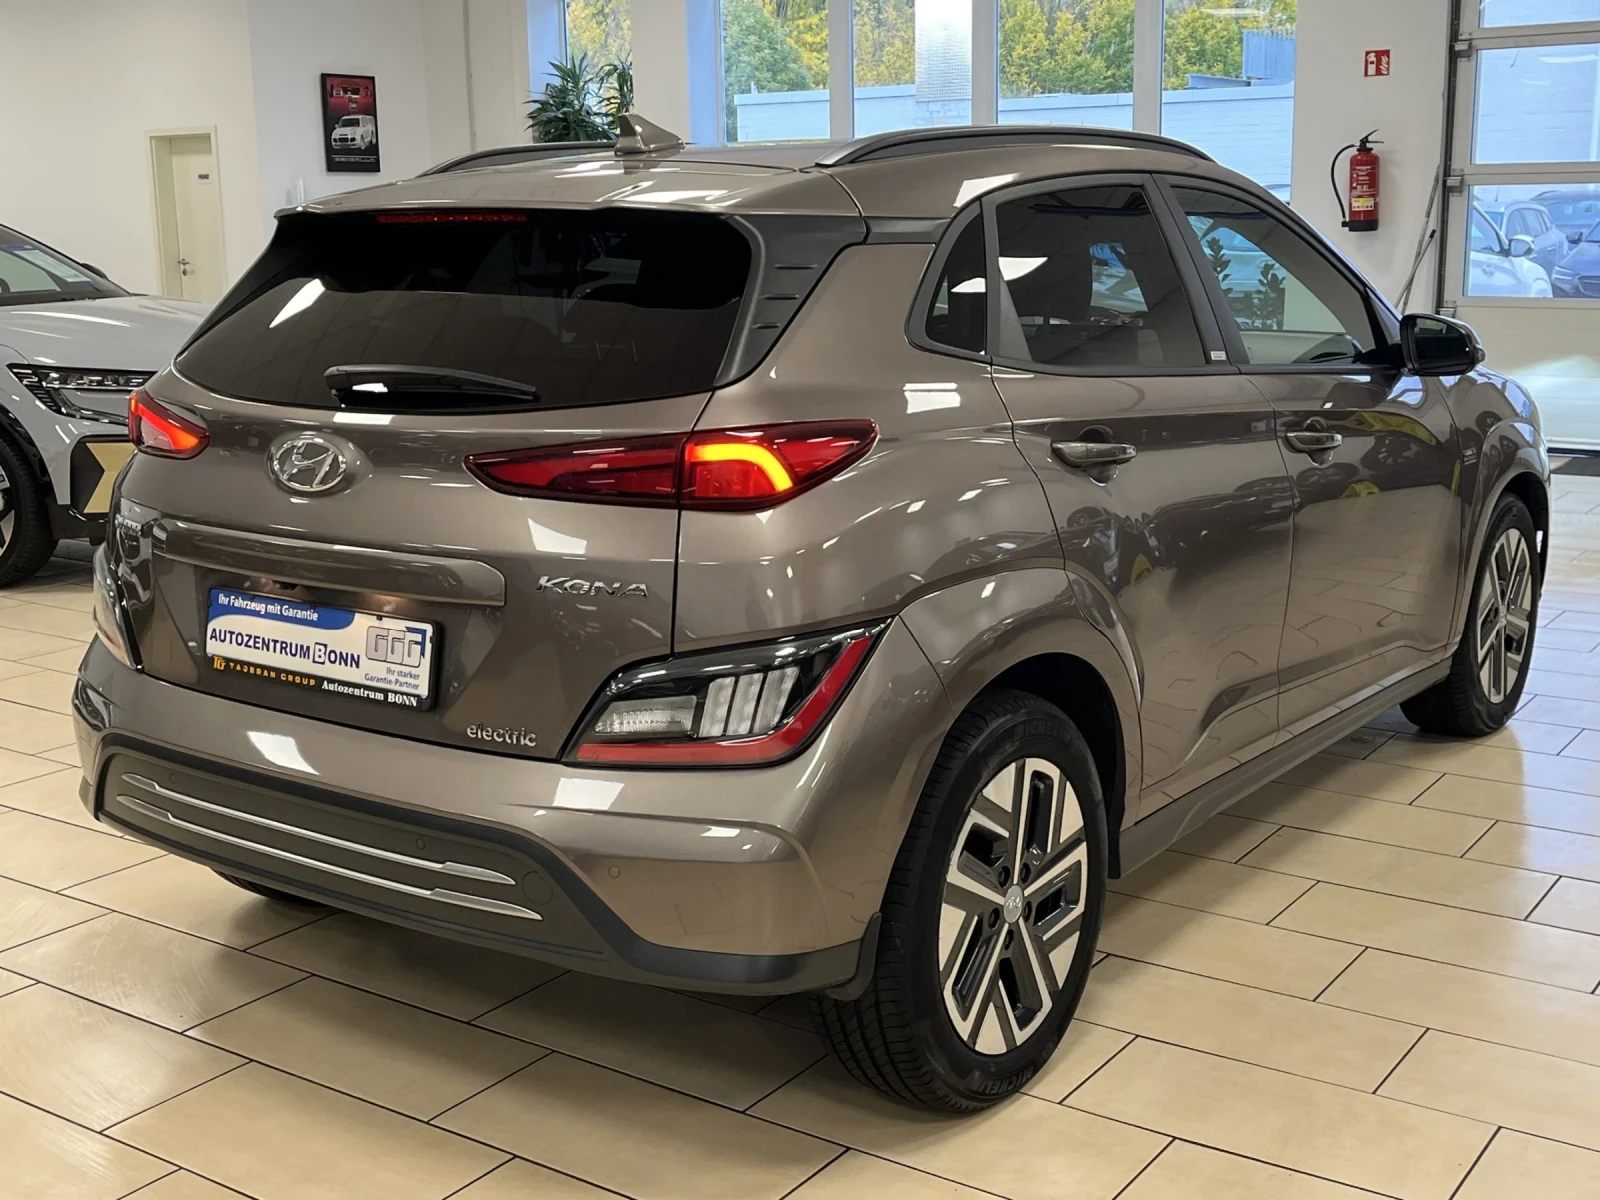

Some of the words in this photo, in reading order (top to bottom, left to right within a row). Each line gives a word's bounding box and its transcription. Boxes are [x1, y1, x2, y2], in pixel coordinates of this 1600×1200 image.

[536, 575, 648, 597] KONA
[218, 593, 228, 605] Ihr
[230, 595, 266, 615] Fahrzeug
[267, 602, 281, 615] mit
[282, 605, 318, 621] Garantie
[209, 627, 311, 660] AUTOZENTRUM
[280, 673, 316, 686] GROUP
[364, 673, 420, 690] Garantie-Partner
[386, 666, 396, 676] Ihr
[397, 669, 420, 680] starker
[321, 680, 384, 701] Autozentrum
[387, 692, 418, 707] BONN
[466, 721, 537, 747] electric
